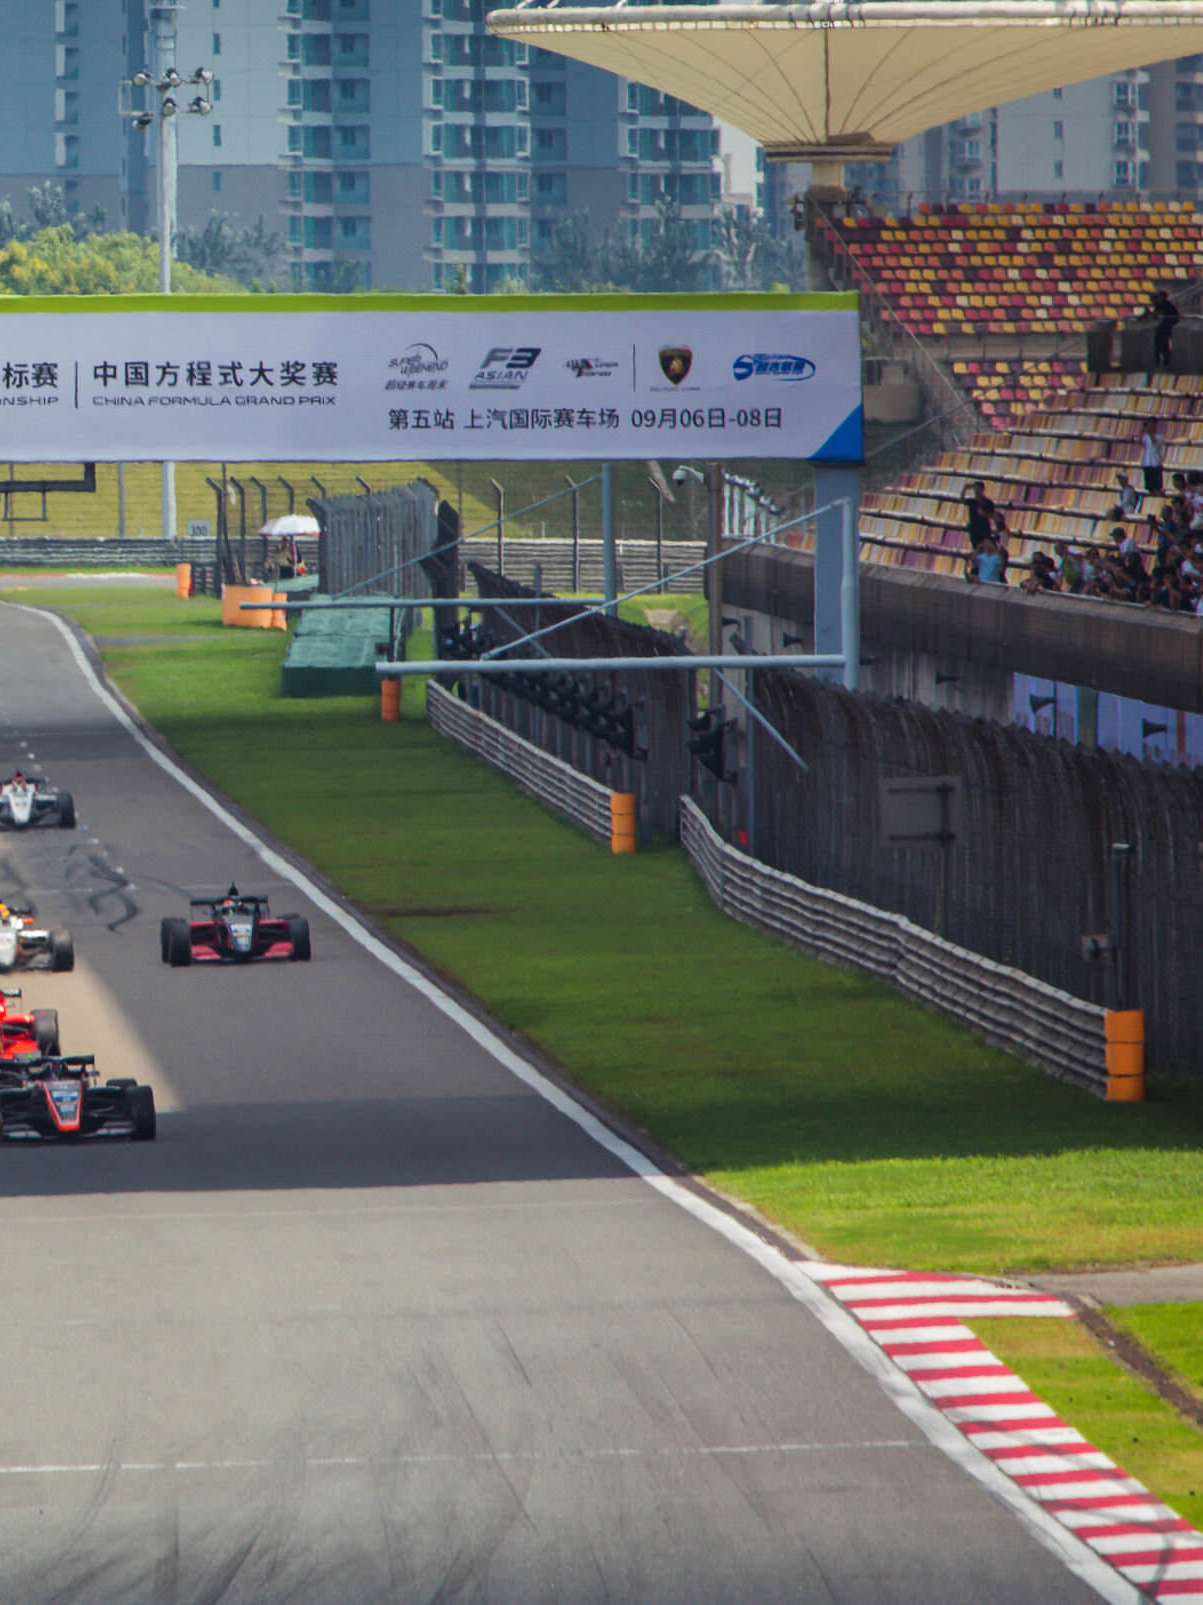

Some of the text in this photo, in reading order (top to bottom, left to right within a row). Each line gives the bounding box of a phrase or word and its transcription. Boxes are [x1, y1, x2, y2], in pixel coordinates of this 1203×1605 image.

[481, 348, 542, 369] F3
[93, 360, 338, 387] 中国方程式大奖赛
[474, 371, 528, 381] ASIAN
[92, 396, 336, 406] CHINA FORMULA GRAND PRIX
[388, 408, 782, 430] 第五站 上汽国际赛车场 09月06日-08日
